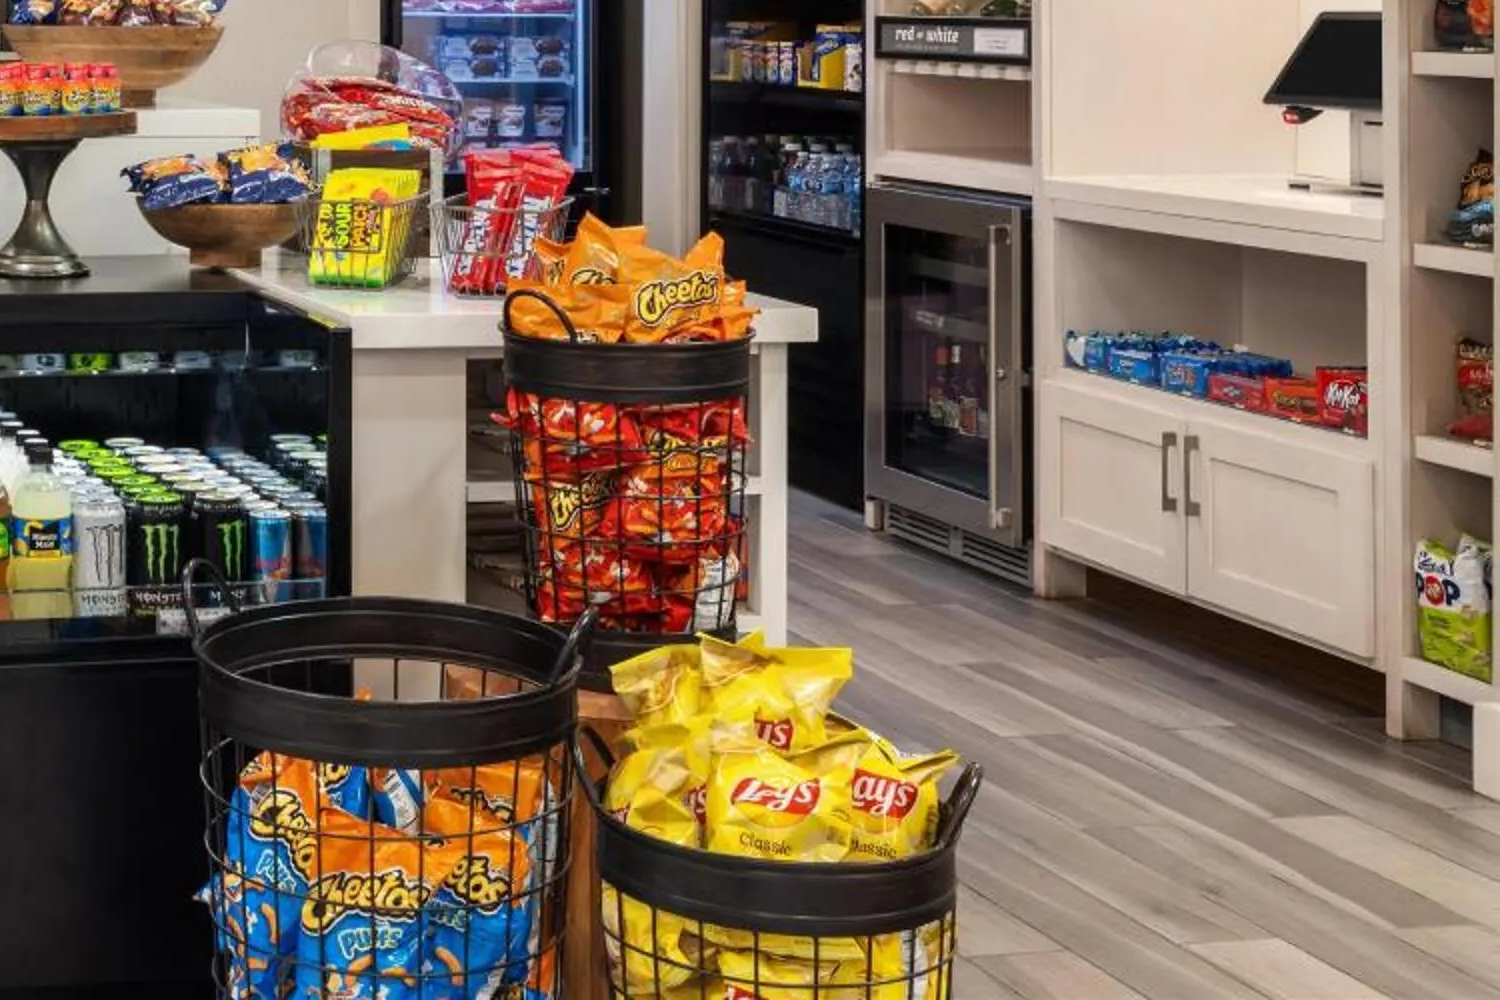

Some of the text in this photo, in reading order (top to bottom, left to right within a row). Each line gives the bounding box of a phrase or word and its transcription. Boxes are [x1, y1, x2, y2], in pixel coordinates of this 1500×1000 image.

[895, 25, 915, 41] red
[926, 26, 959, 43] white
[335, 202, 352, 248] SOUR
[637, 271, 719, 325] Cheetos
[135, 591, 183, 604] MONSTE
[740, 832, 792, 856] Classic
[850, 838, 897, 859] lassic
